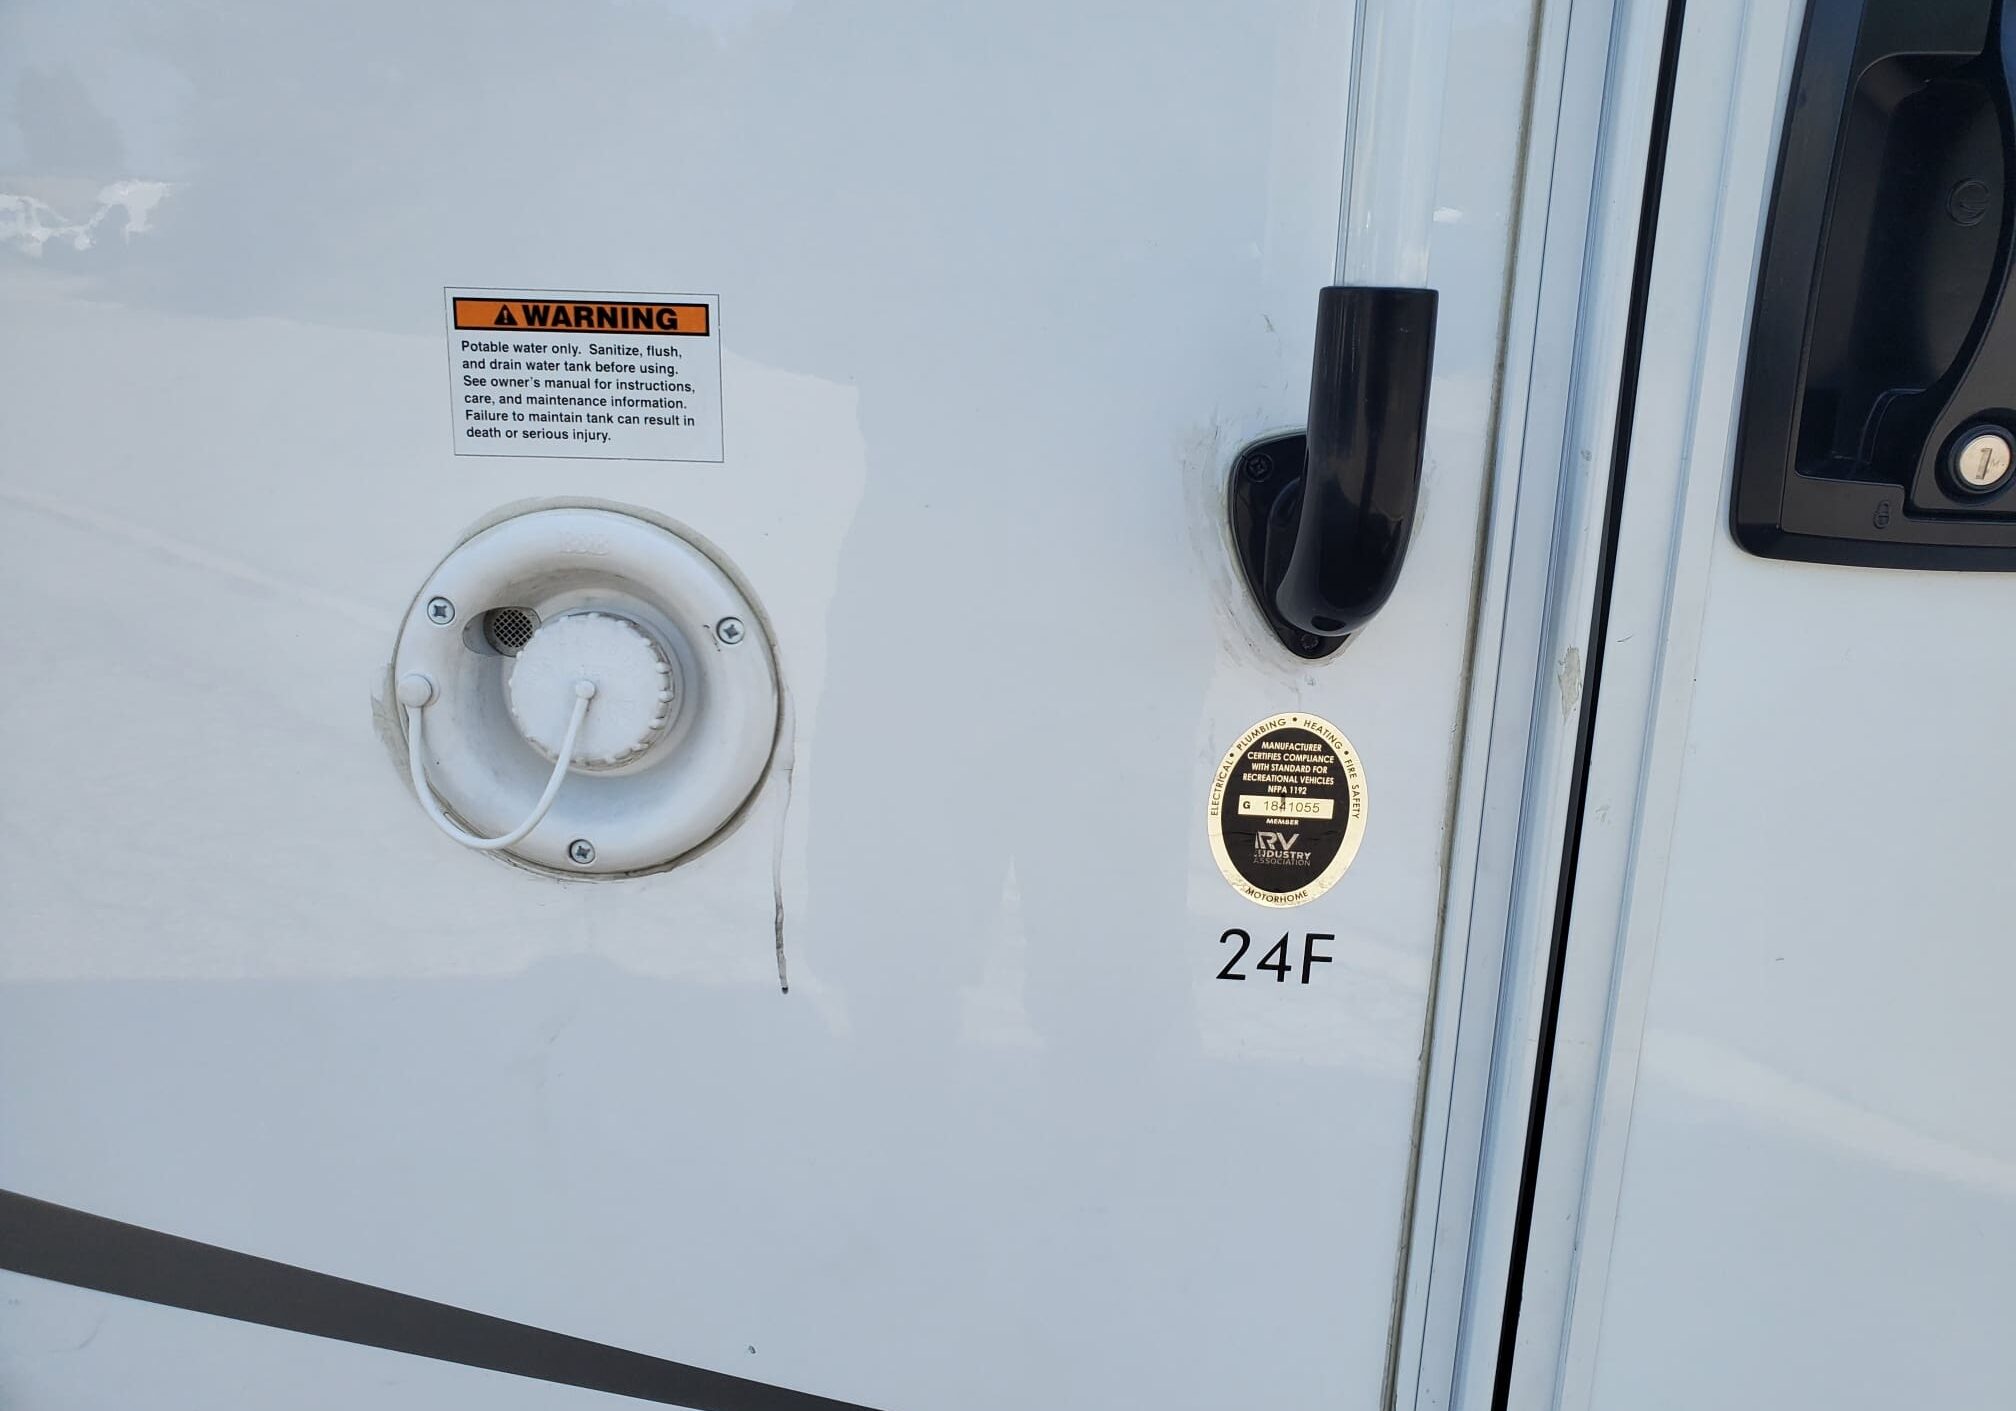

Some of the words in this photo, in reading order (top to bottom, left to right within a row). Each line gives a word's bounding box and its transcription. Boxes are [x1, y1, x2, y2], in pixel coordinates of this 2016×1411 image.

[522, 304, 678, 330] WARNING
[461, 341, 509, 353] Potable
[513, 343, 547, 353] water
[552, 343, 582, 356] only.
[589, 344, 643, 357] Sanitize,
[647, 345, 682, 358] flush,
[462, 359, 486, 369] and
[490, 359, 522, 370] drain
[526, 362, 560, 371] water
[564, 362, 591, 372] tank
[595, 362, 636, 373] before
[640, 365, 678, 377] using.
[463, 376, 487, 387] See
[491, 377, 540, 388] owner's
[544, 379, 591, 389] manual
[594, 380, 612, 390] for
[616, 380, 695, 394] instructions,
[464, 395, 495, 406] care,
[499, 394, 522, 405] and
[526, 396, 607, 407] maintenance
[611, 397, 687, 409] information.
[465, 410, 508, 422] Failure
[512, 412, 525, 422] to
[528, 412, 583, 423] maintain
[586, 413, 614, 424] tank
[617, 415, 640, 425] can
[644, 414, 680, 426] result
[683, 415, 695, 426] in
[466, 427, 502, 439] death
[505, 430, 519, 439] or
[522, 429, 569, 440] serious
[572, 430, 611, 443] injury.
[1261, 741, 1322, 751] MANUFACTURER
[1248, 753, 1282, 761] CERTIFIES
[1283, 754, 1335, 763] COMPLIANCE
[1210, 760, 1234, 816] ELECTRICAL
[1237, 718, 1286, 750] PLUMBING
[1304, 720, 1343, 750] HEATING
[1344, 759, 1356, 779] FIRE
[1351, 785, 1361, 819] SAFETY
[1252, 763, 1269, 771] WITH
[1271, 764, 1311, 772] STANDARD
[1312, 765, 1327, 773] FOR
[1242, 774, 1298, 783] RECREATIONAL
[1300, 776, 1334, 785] VEHICLES
[1268, 785, 1288, 794] NFPA
[1290, 786, 1307, 794] 1192
[1243, 801, 1251, 810] G
[1253, 858, 1311, 866] ASSOCIATION
[1245, 887, 1308, 903] MOTORHOME
[1216, 928, 1335, 984] 24F
